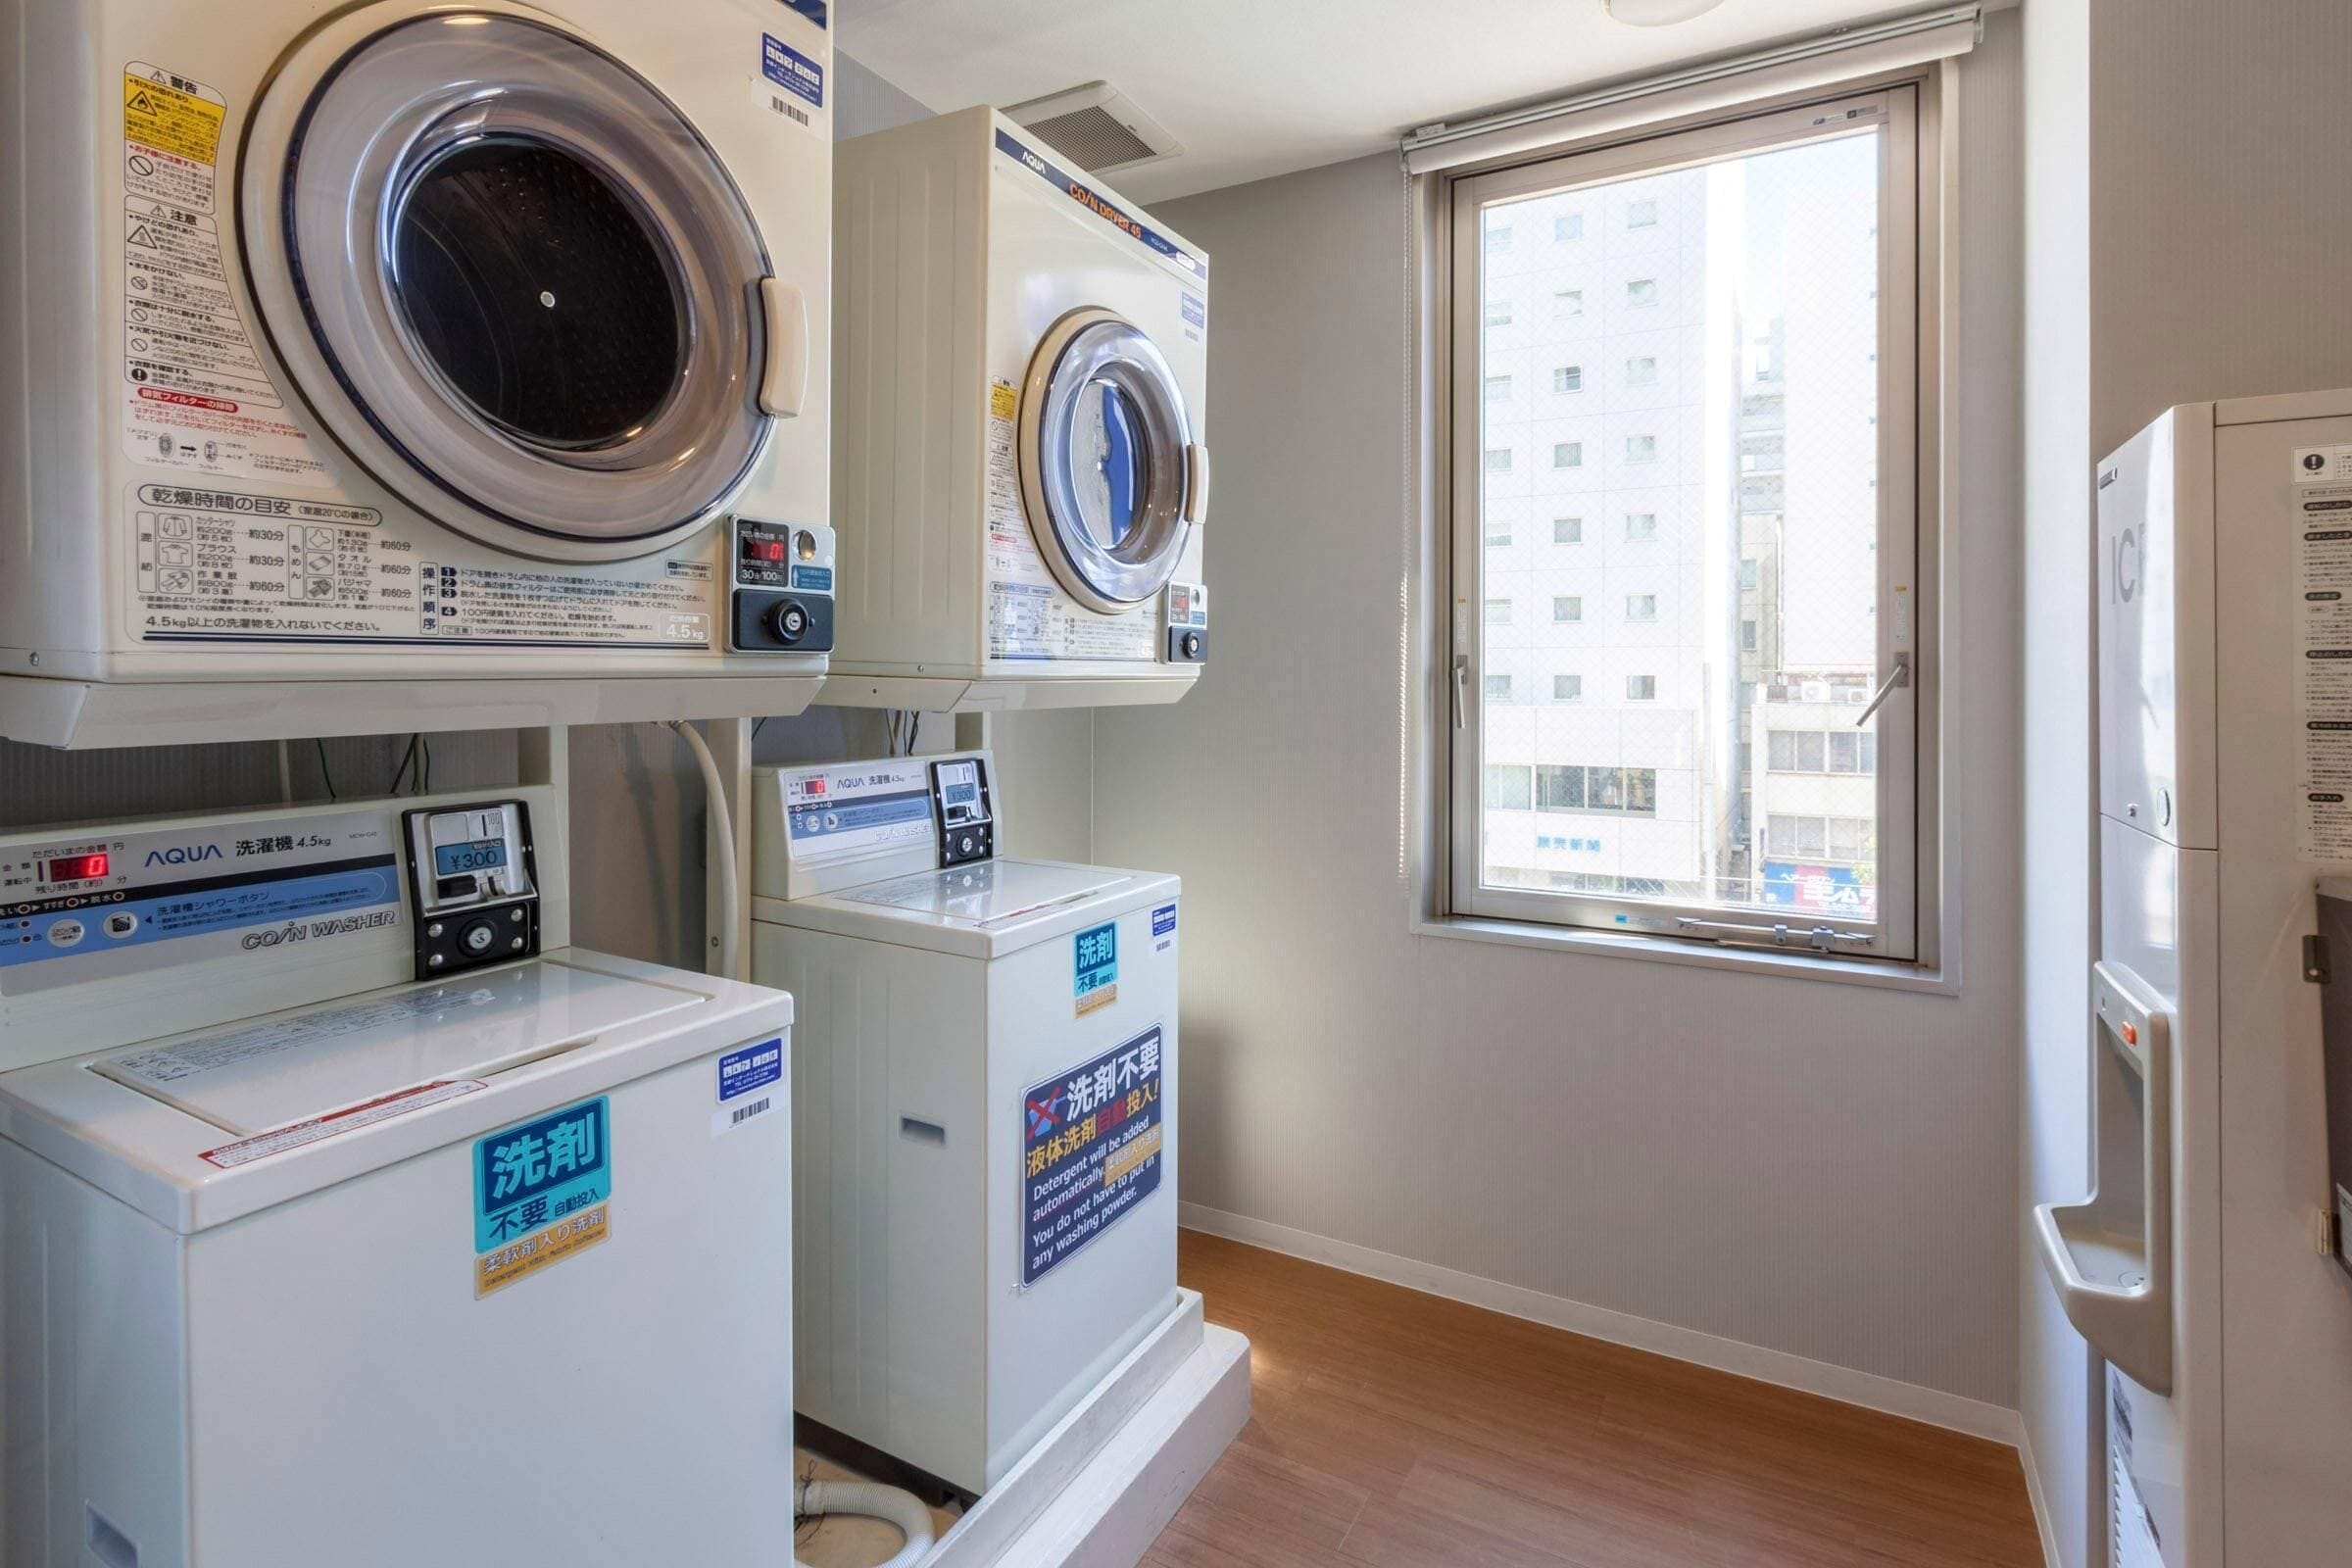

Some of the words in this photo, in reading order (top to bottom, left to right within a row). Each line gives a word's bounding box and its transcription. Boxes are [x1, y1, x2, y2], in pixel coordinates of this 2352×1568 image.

[171, 75, 198, 94] 警告
[1022, 151, 1047, 173] AQUA
[171, 210, 197, 226] 注意
[1100, 204, 1130, 231] DRYER
[1130, 223, 1142, 240] 45
[135, 263, 185, 279] 水をかけない。
[134, 326, 229, 351] 火気や引火物を近づけない。
[134, 361, 192, 377] 衣類を確認する。
[141, 388, 235, 413] 排気フィルターの掃除
[151, 488, 292, 515] 乾燥時間の目安
[249, 529, 284, 542] 約30分
[197, 544, 237, 555] ブラウス
[380, 540, 412, 552] 約60分
[769, 543, 781, 560] 0
[249, 555, 284, 567] 約30分
[291, 545, 301, 580] もめん
[338, 554, 371, 564] タオル
[380, 564, 412, 575] 約60分
[249, 581, 284, 593] 約60分
[380, 588, 412, 599] 約60分
[422, 566, 436, 630] 操作順序
[145, 616, 381, 632] 4.5kg以上の洗濯物を入れないでください。
[666, 623, 691, 639] 4.5
[837, 778, 864, 790] AQUA
[868, 775, 891, 786] 洗濯機
[32, 844, 108, 858] ただいまの金額
[113, 842, 125, 851] 円
[145, 844, 222, 867] AQUA
[235, 835, 295, 857] 洗濯機
[296, 835, 331, 849] 4.5kg
[88, 857, 104, 876] 0
[451, 850, 497, 870] ¥300
[35, 881, 79, 894] 残り時間
[157, 890, 270, 917] 洗濯槽シャワーボタン
[312, 910, 396, 938] WASHER
[1079, 929, 1113, 968] 洗剤
[1078, 971, 1098, 993] 不要
[1066, 1036, 1159, 1122] 洗剤不要
[492, 1111, 596, 1200] 洗剤
[1034, 1156, 1088, 1201] Detergent
[1090, 1142, 1106, 1165] will
[1109, 1136, 1121, 1152] be
[1122, 1116, 1150, 1144] added
[1033, 1227, 1054, 1249] You
[1056, 1210, 1071, 1229] do
[1073, 1198, 1091, 1222] not
[1093, 1182, 1116, 1208] have
[1117, 1174, 1128, 1189] to
[1129, 1160, 1145, 1184] put
[1147, 1154, 1154, 1169] in
[489, 1195, 549, 1241] 不要
[554, 1188, 601, 1217] 自動投入
[1032, 1249, 1054, 1271] any
[1056, 1213, 1100, 1252] washing
[1101, 1186, 1138, 1229] powder.
[483, 1206, 605, 1274] 柔軟剤入り洗剤
